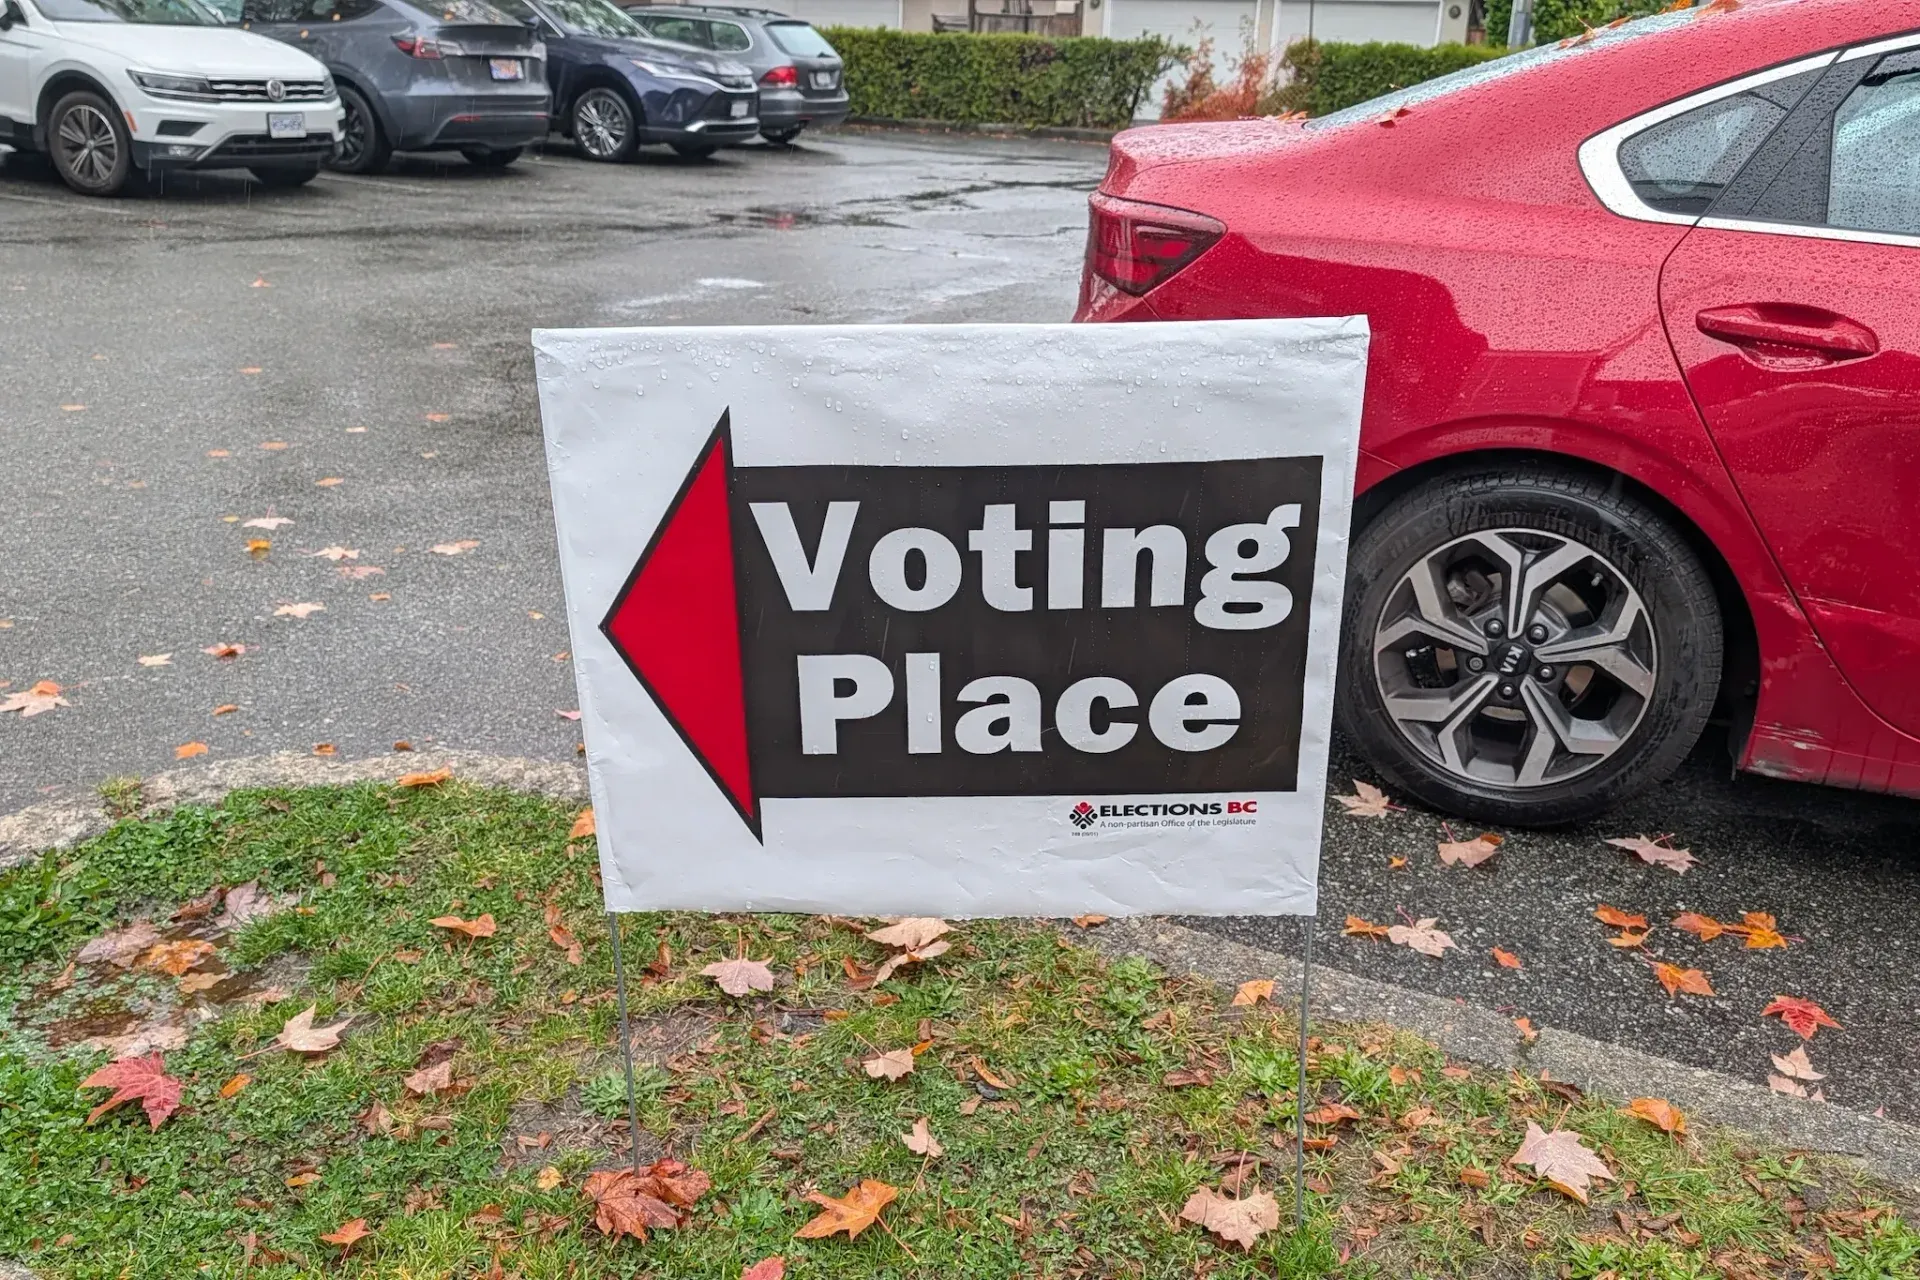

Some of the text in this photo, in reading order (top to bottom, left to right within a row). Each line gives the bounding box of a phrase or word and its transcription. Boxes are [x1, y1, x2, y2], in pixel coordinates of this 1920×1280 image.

[748, 499, 1302, 630] Voting
[1499, 645, 1524, 673] KIA
[797, 652, 1242, 756] Place
[1100, 801, 1258, 817] ELECTIONS BC
[1107, 819, 1159, 829] non-partisan
[1160, 819, 1186, 828] Office
[1187, 819, 1196, 827] of
[1197, 818, 1211, 827] the
[1212, 817, 1257, 827] Legislature
